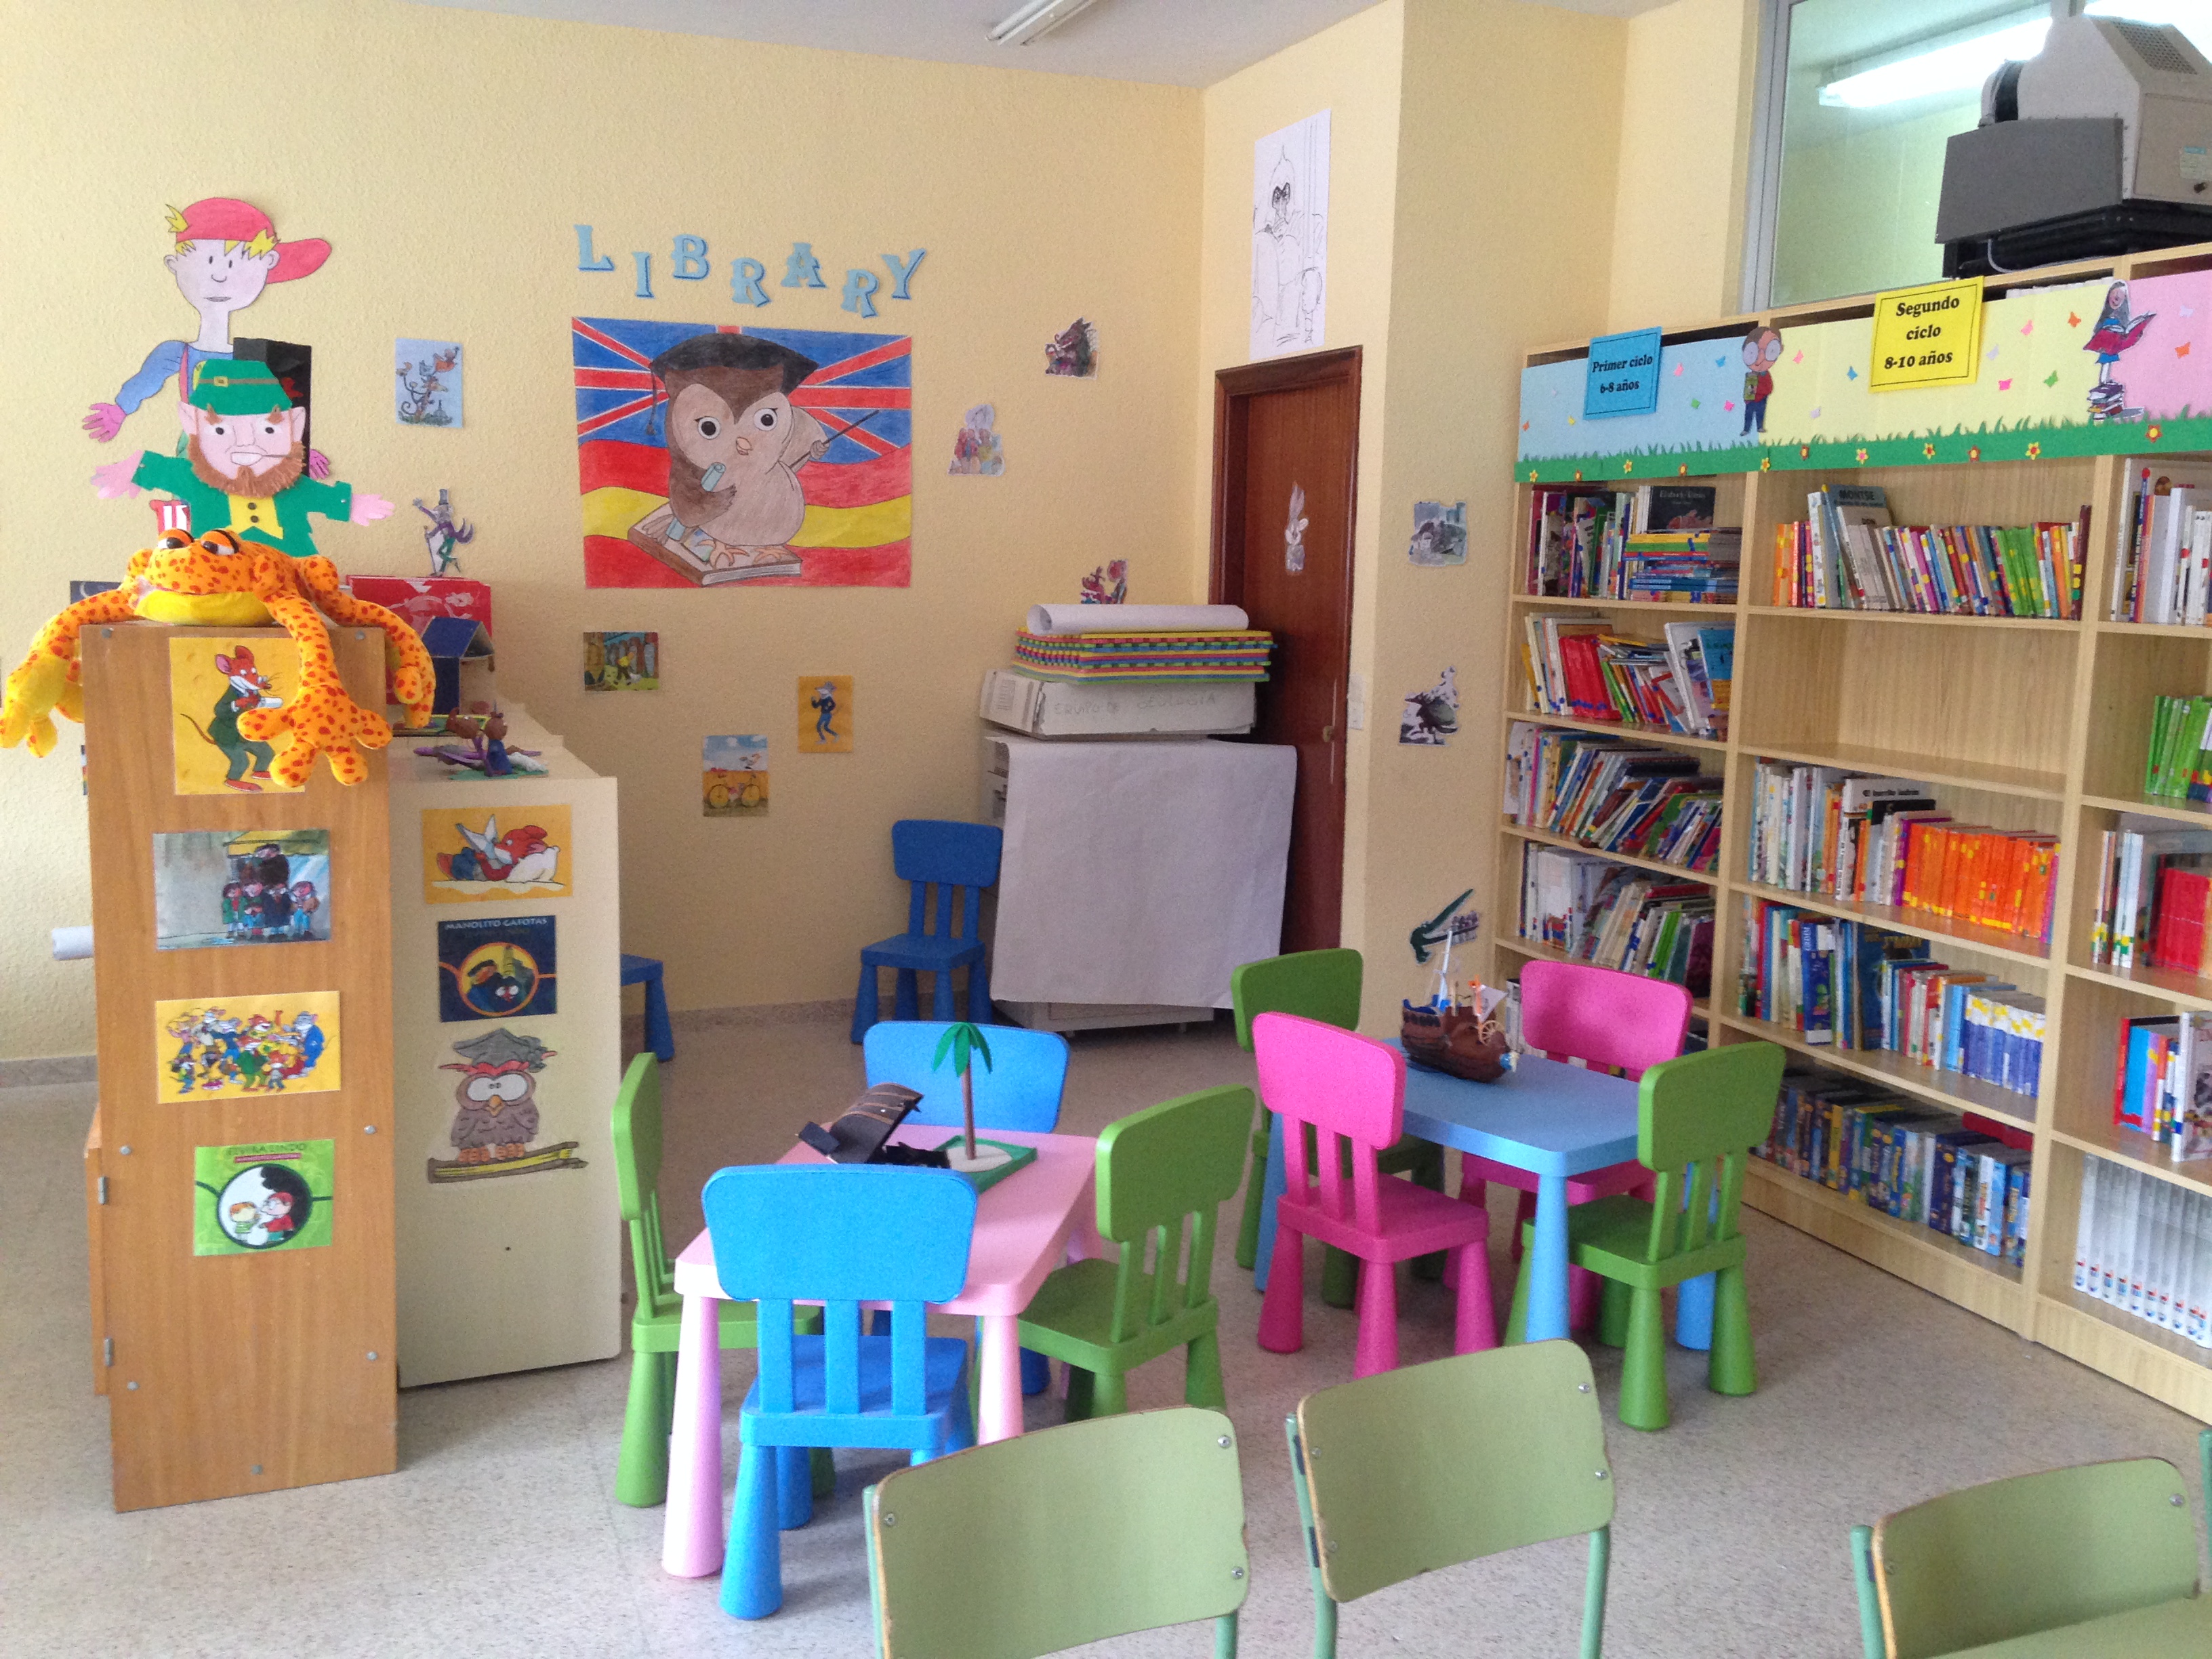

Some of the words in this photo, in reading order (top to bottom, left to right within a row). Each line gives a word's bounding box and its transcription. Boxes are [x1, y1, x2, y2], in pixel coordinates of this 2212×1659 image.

[574, 224, 927, 319] LIBRARY
[1896, 295, 1960, 317] Segundo
[1906, 324, 1942, 340] ciclo
[1592, 360, 1628, 373] Primer
[1629, 354, 1653, 367] ciclo
[1884, 355, 1915, 369] 8-10
[1919, 350, 1953, 366] años
[1600, 382, 1614, 394] 6-8
[1616, 379, 1639, 392] años
[445, 920, 501, 930] MANOLITO
